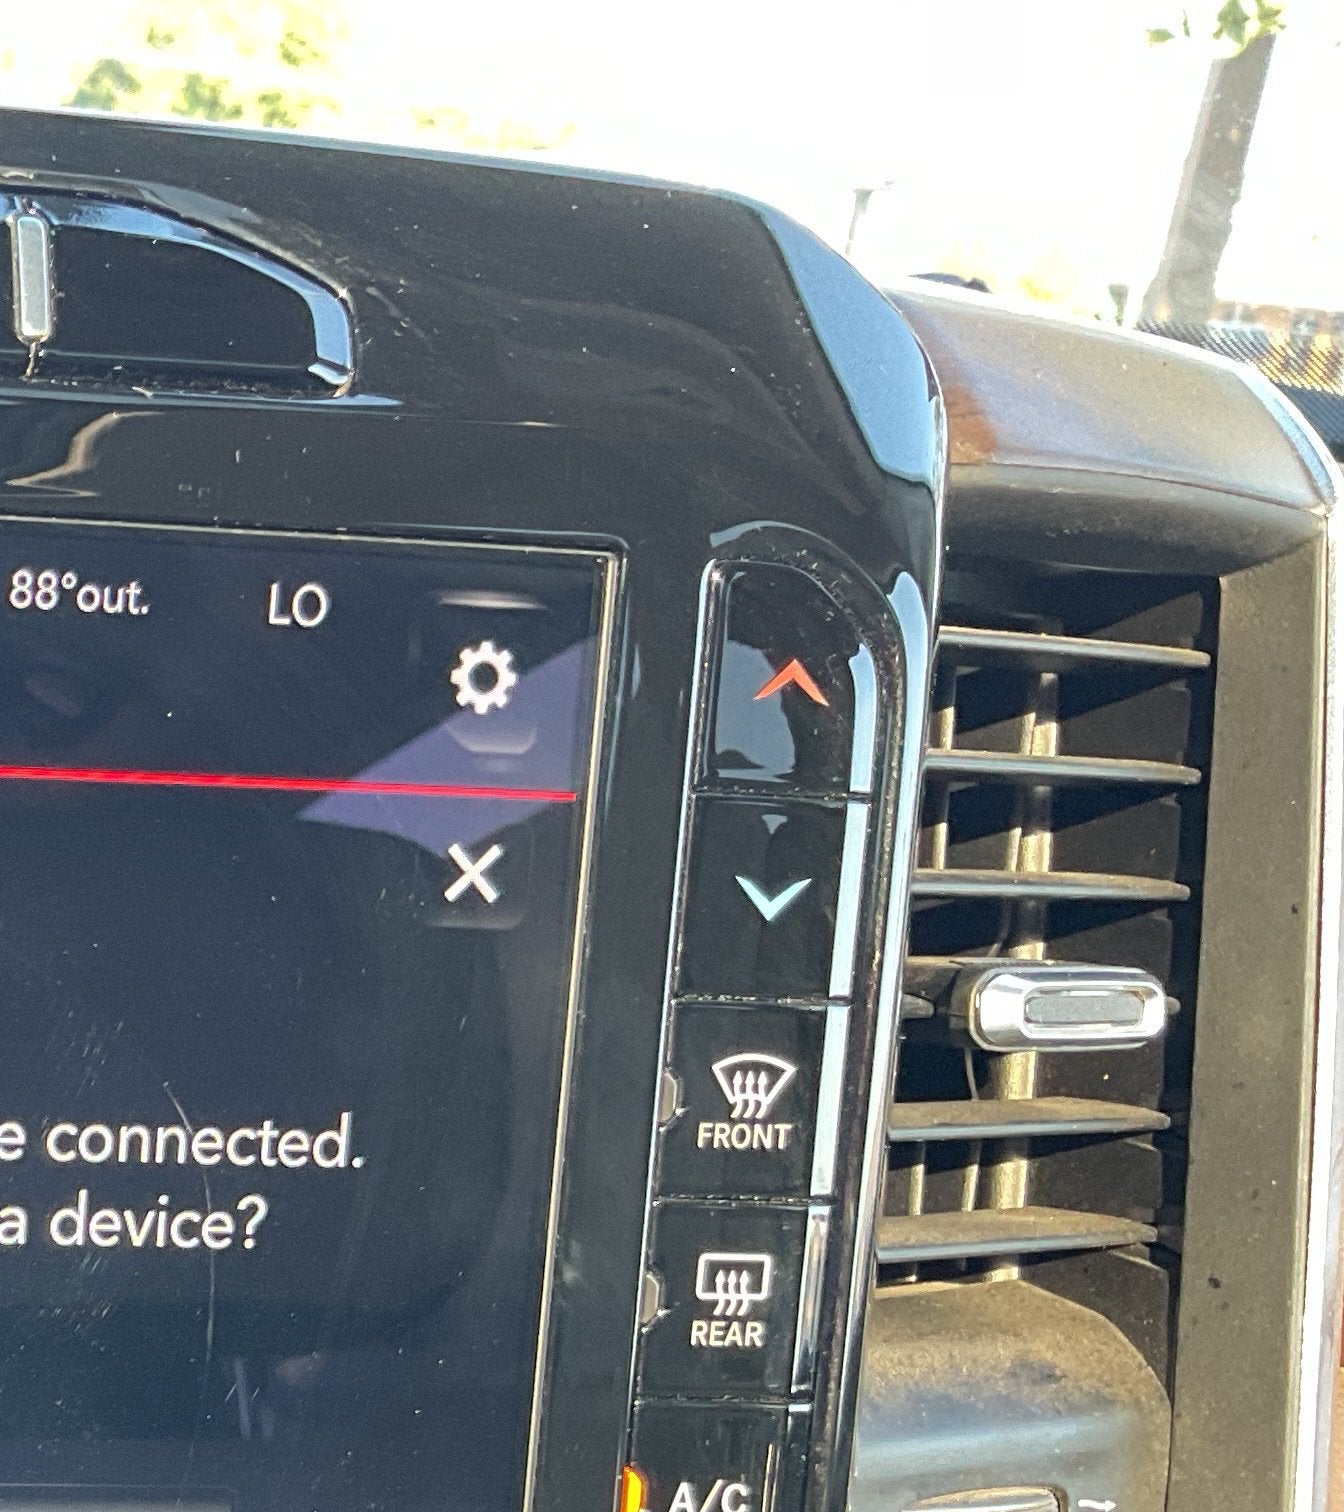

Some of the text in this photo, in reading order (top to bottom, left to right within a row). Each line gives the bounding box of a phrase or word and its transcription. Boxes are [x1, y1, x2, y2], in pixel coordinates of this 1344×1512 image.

[269, 583, 329, 627] LO
[47, 1113, 363, 1168] connected.
[698, 1123, 793, 1150] FRONT
[50, 1196, 268, 1250] device?
[691, 1320, 765, 1348] REAR
